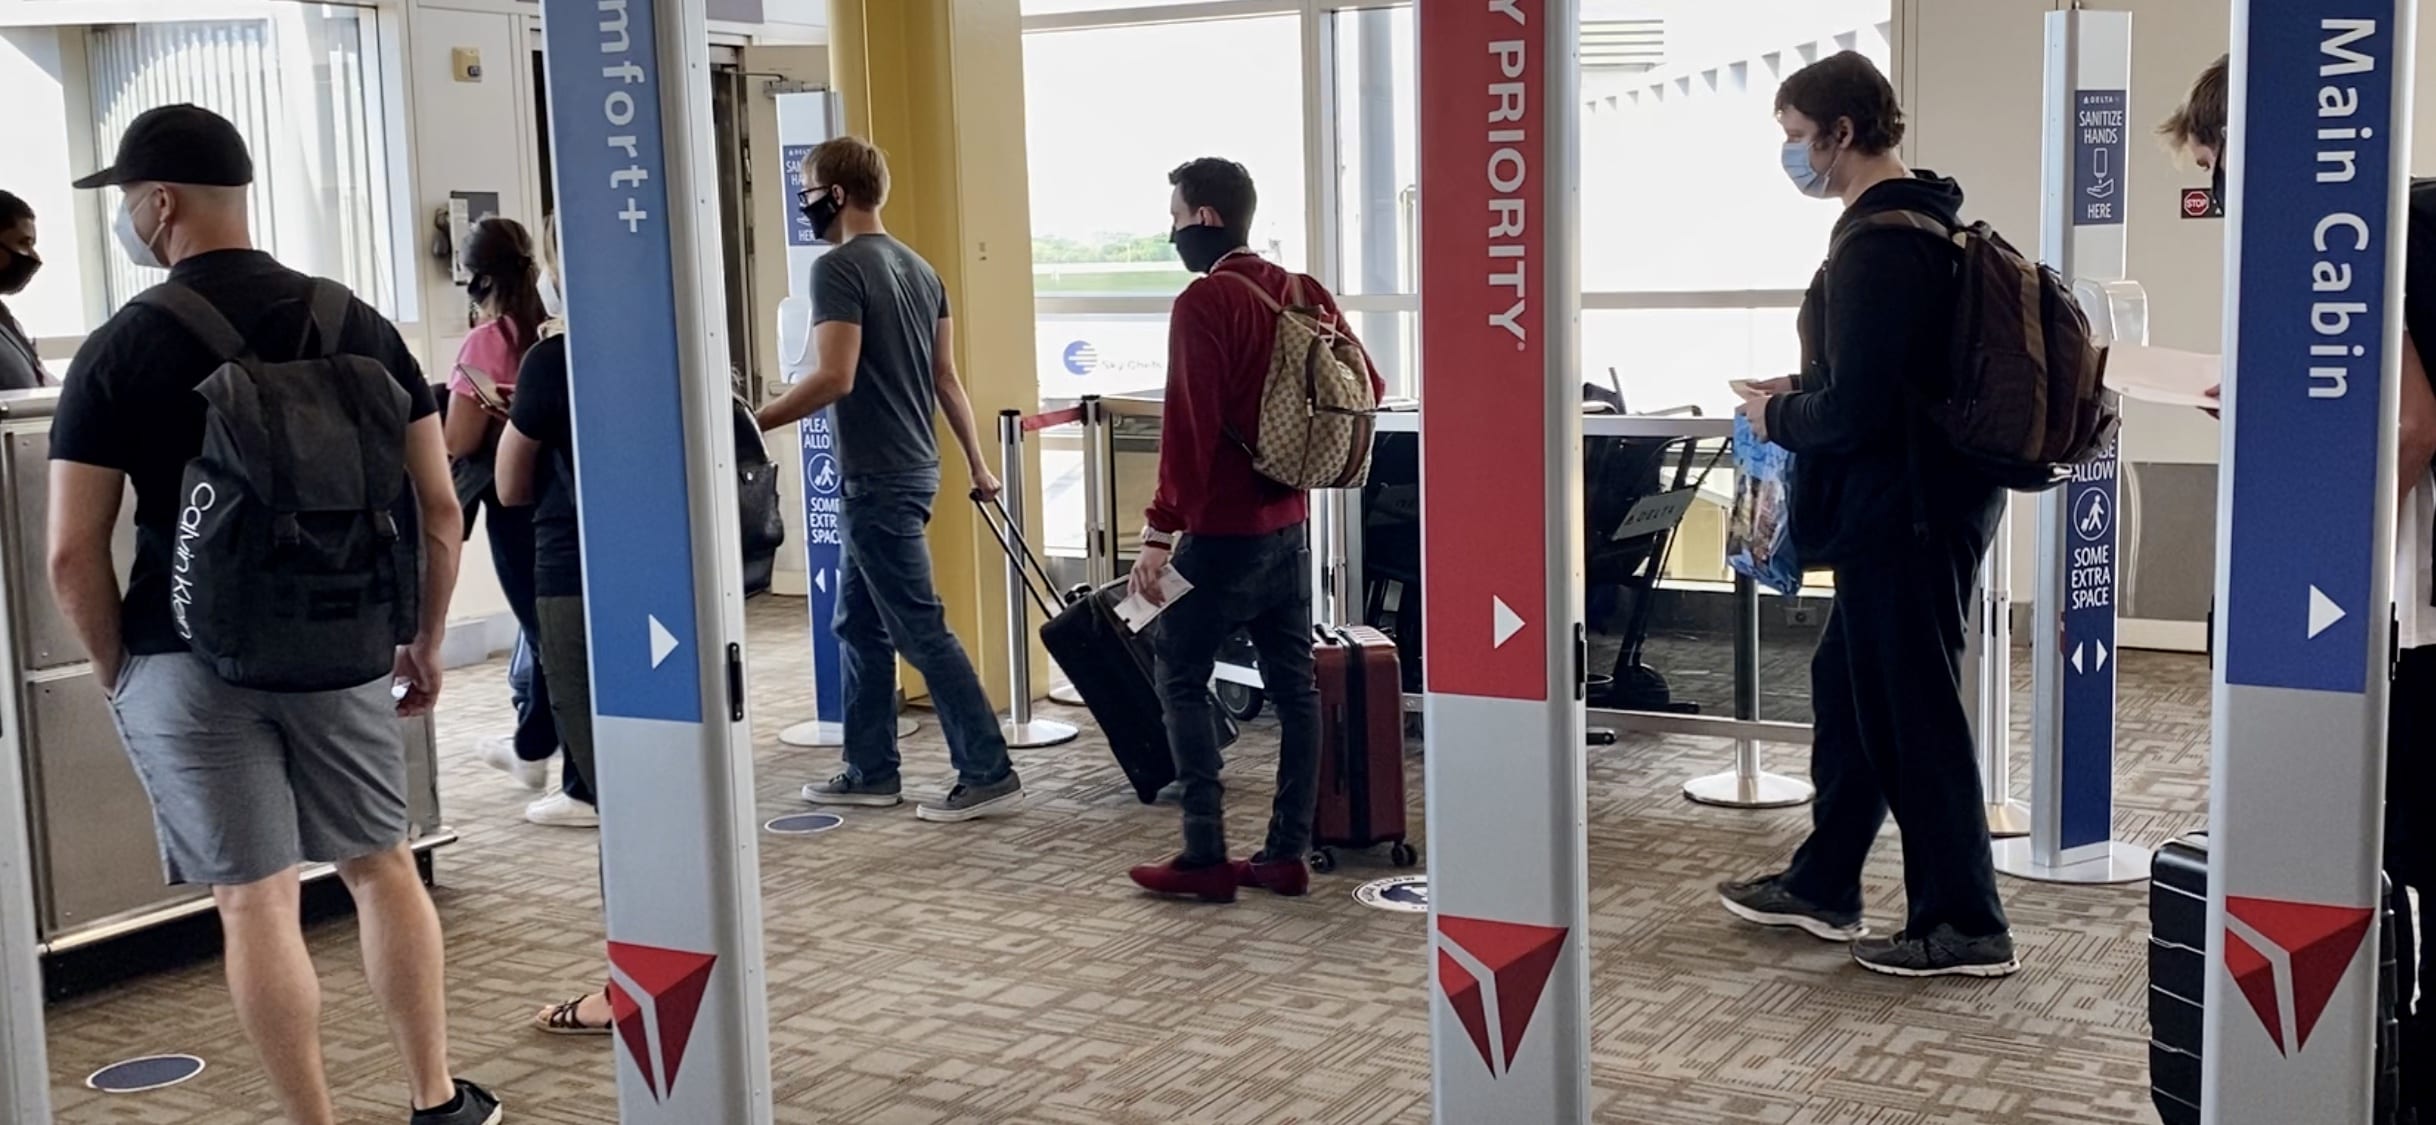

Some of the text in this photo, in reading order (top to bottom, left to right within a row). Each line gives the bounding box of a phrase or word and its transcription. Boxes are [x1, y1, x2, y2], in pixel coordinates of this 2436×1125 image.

[2079, 110, 2123, 127] SANITIZE
[2083, 128, 2118, 144] HANDS
[1487, 40, 1526, 342] PRIORITY
[2087, 203, 2112, 219] HERE
[2186, 198, 2207, 209] STOP
[2308, 19, 2376, 398] Main Cabin
[803, 418, 829, 433] PLEA
[804, 433, 830, 450] ALLO
[2072, 461, 2115, 483] ALLOW
[175, 482, 216, 573] Calvin
[809, 513, 838, 528] EXTR
[811, 529, 842, 544] SPAC
[2074, 545, 2110, 567] SOME
[2071, 566, 2111, 588] EXTRA
[2072, 587, 2109, 609] SPACE
